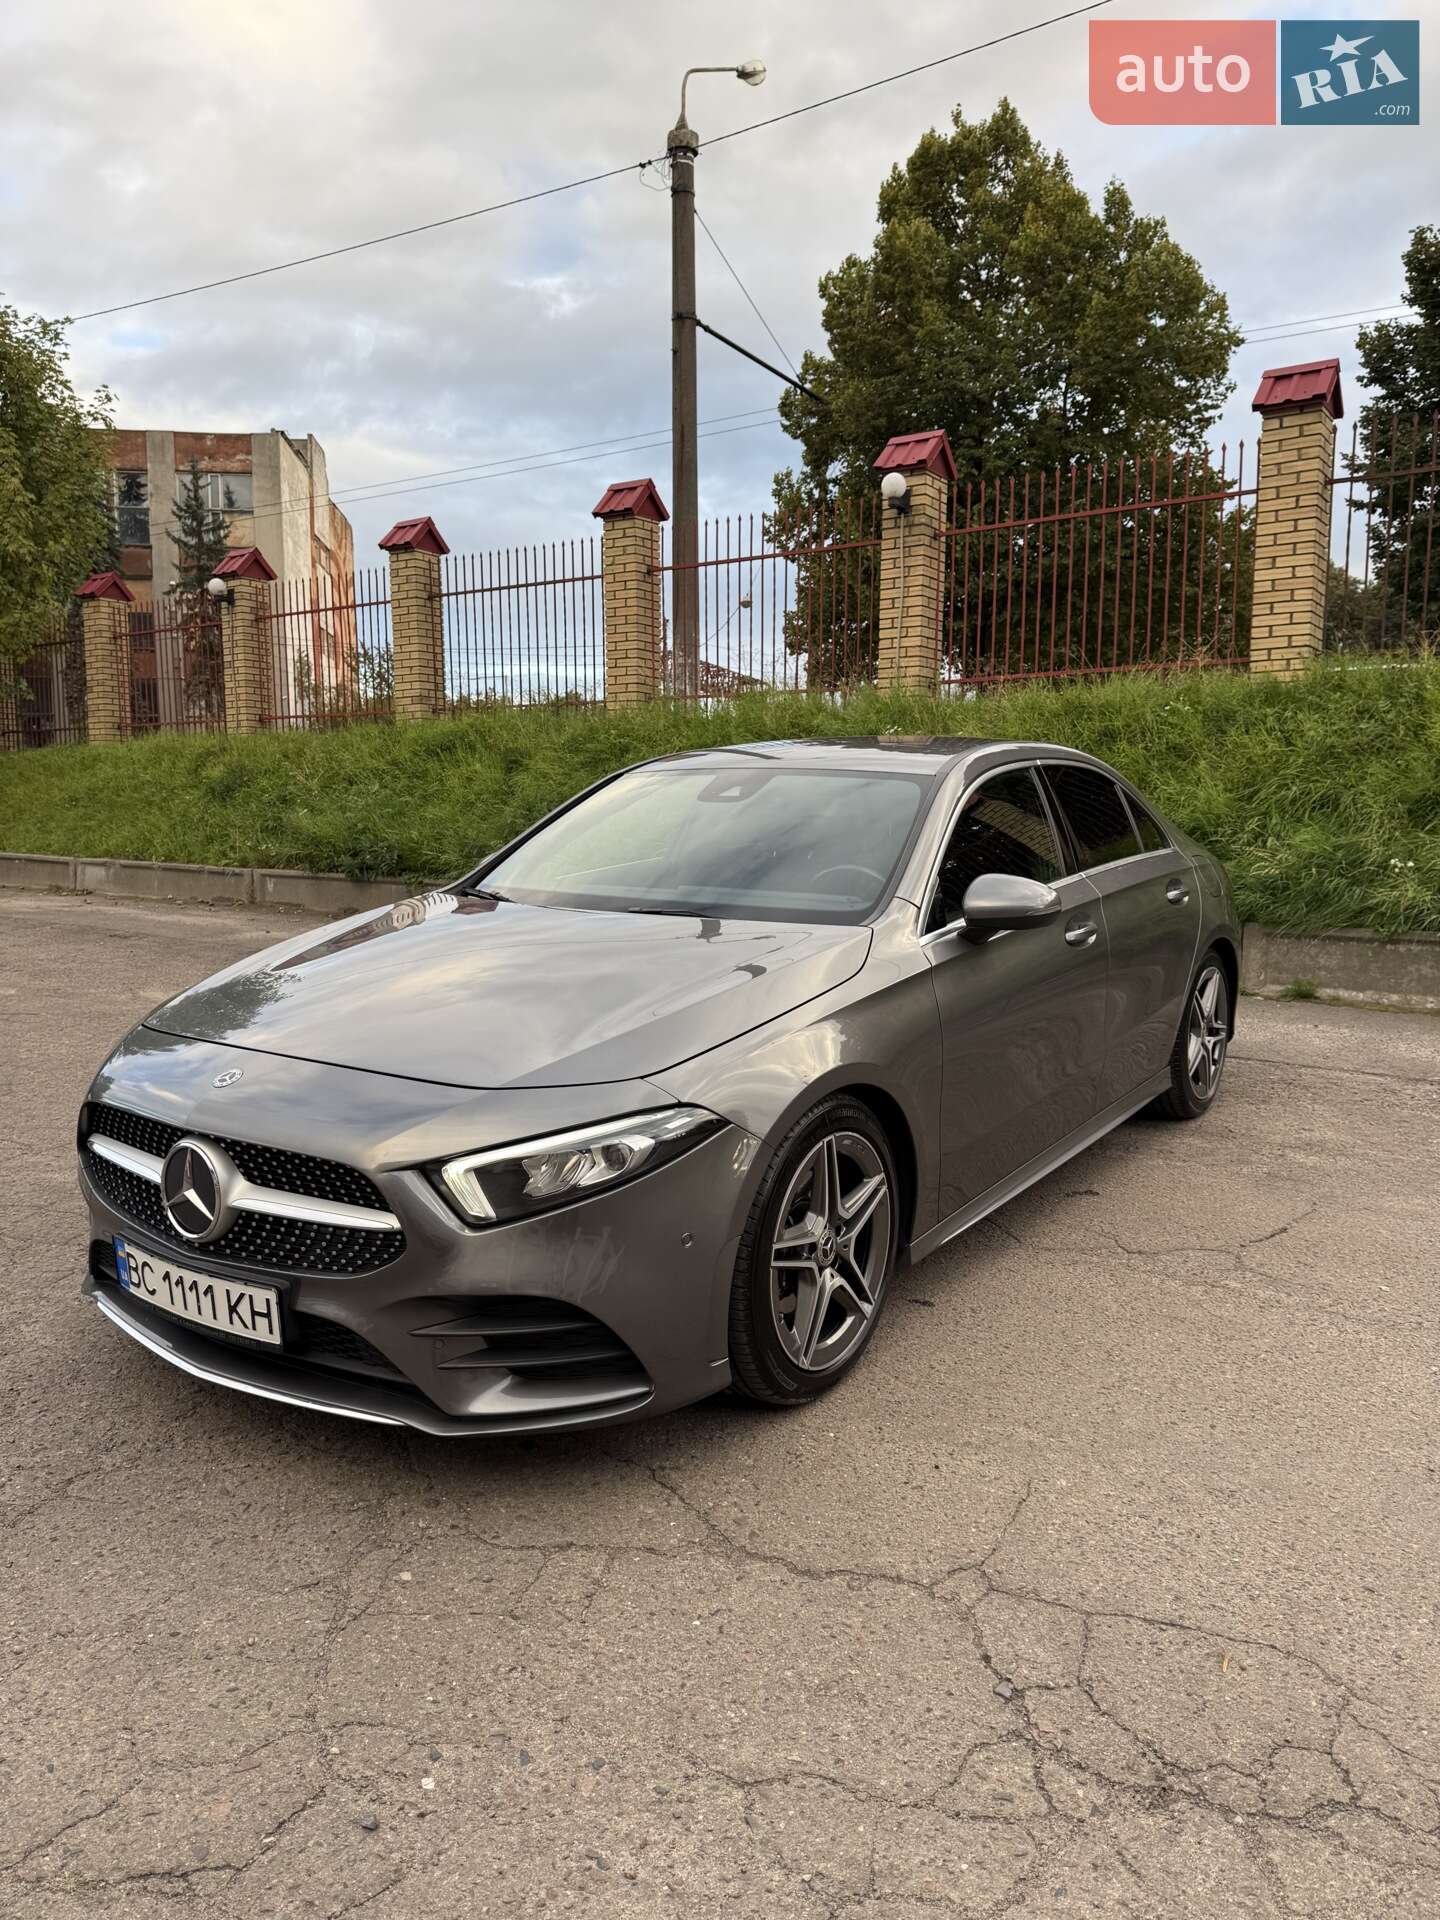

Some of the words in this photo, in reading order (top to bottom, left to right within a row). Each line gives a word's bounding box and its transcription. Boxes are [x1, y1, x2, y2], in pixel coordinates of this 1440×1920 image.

[127, 1251, 157, 1296] BC
[162, 1270, 218, 1321] 1111
[225, 1288, 274, 1335] KH
